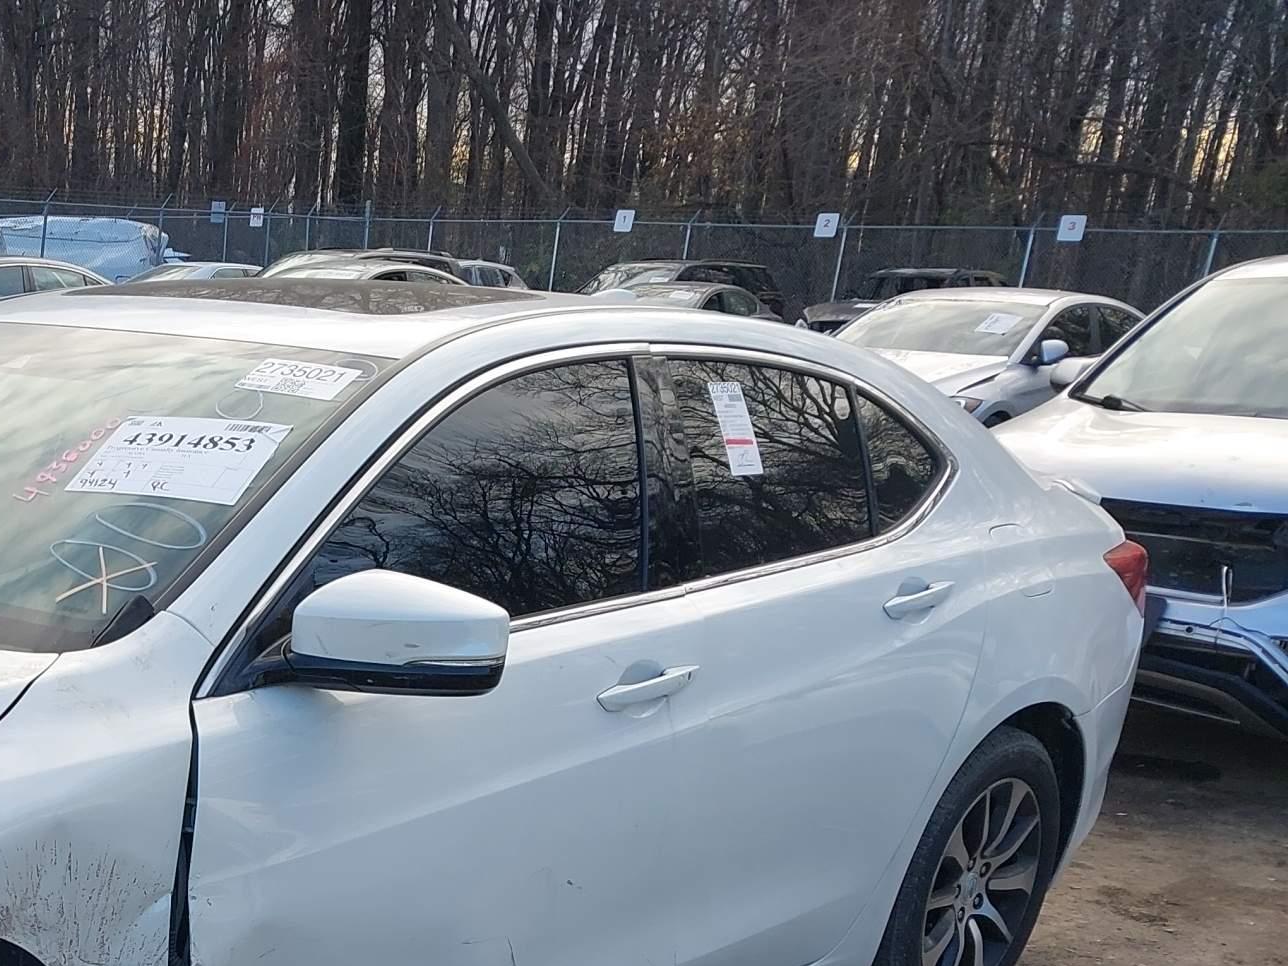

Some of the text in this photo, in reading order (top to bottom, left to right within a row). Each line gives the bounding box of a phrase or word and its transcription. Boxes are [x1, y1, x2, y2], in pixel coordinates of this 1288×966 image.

[823, 219, 831, 228] 2
[1067, 221, 1077, 231] 3
[256, 361, 347, 383] 2735021
[123, 431, 257, 453] 43914853
